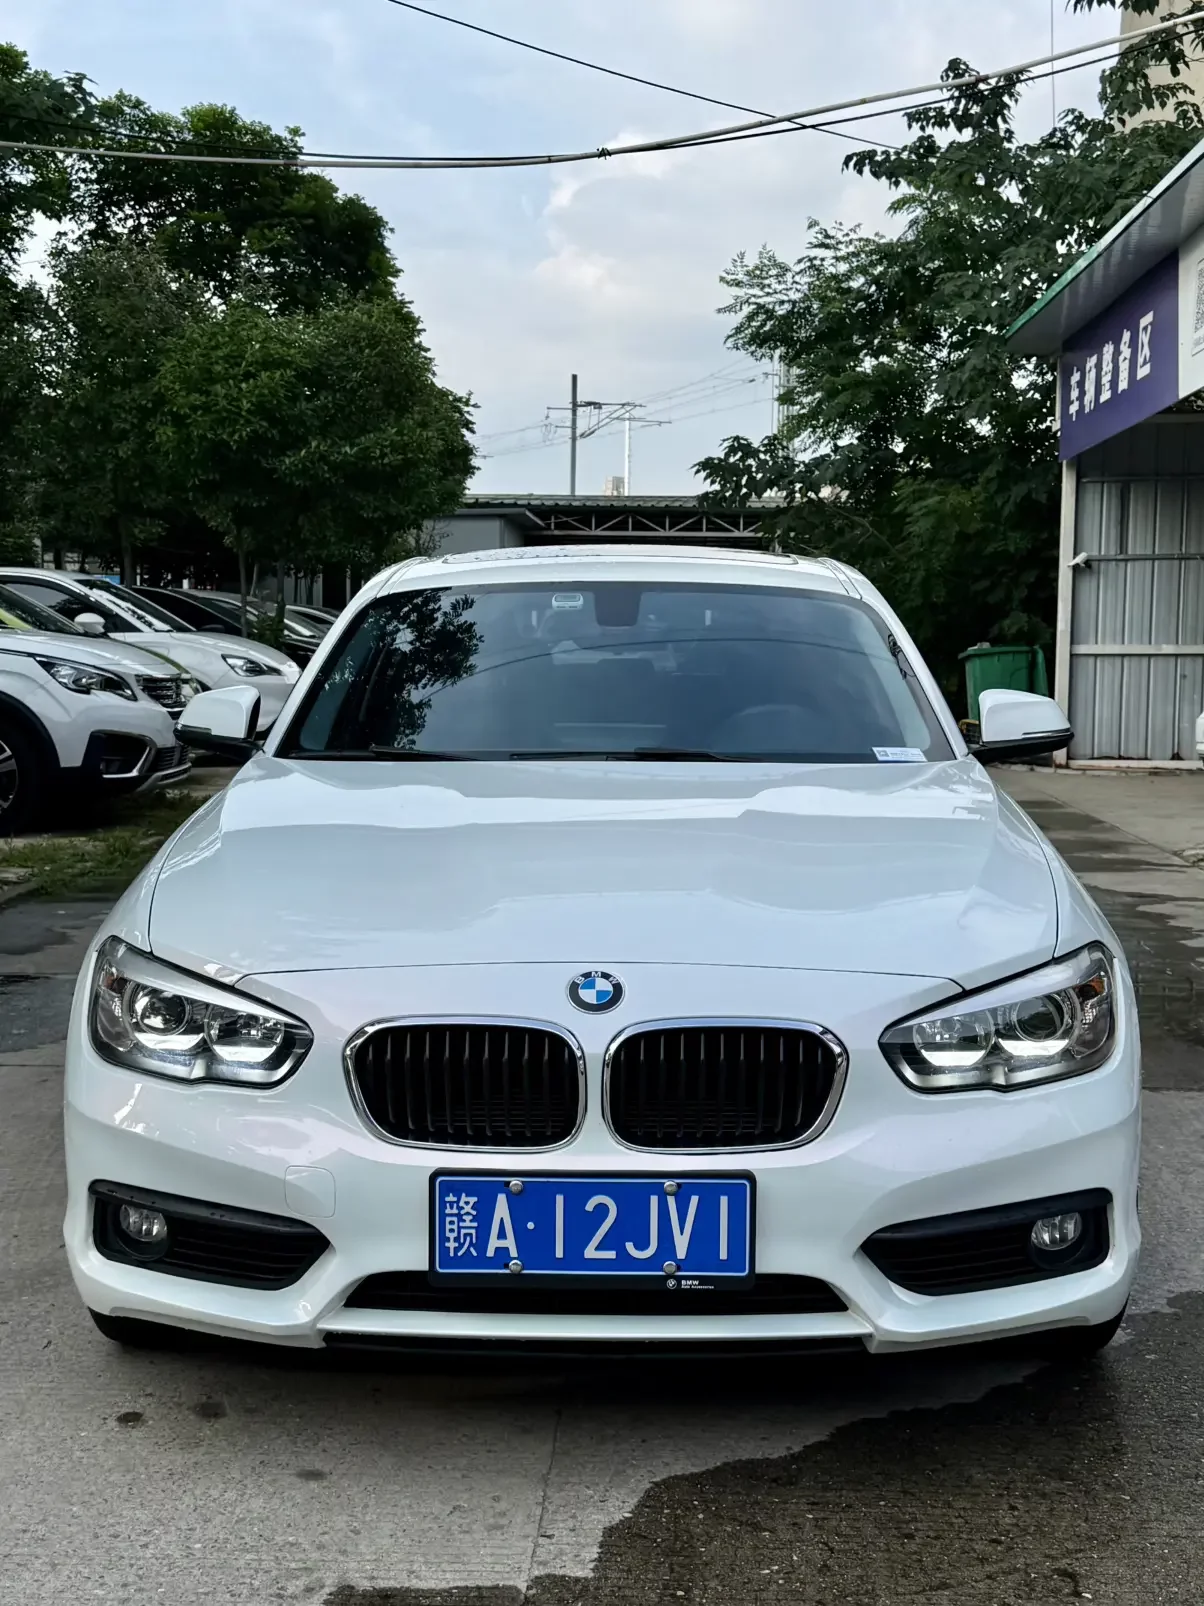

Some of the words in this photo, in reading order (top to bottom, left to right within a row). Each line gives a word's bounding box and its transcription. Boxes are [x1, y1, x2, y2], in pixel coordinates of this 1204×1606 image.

[1068, 310, 1154, 421] 车辆整备区
[574, 971, 621, 984] BMW
